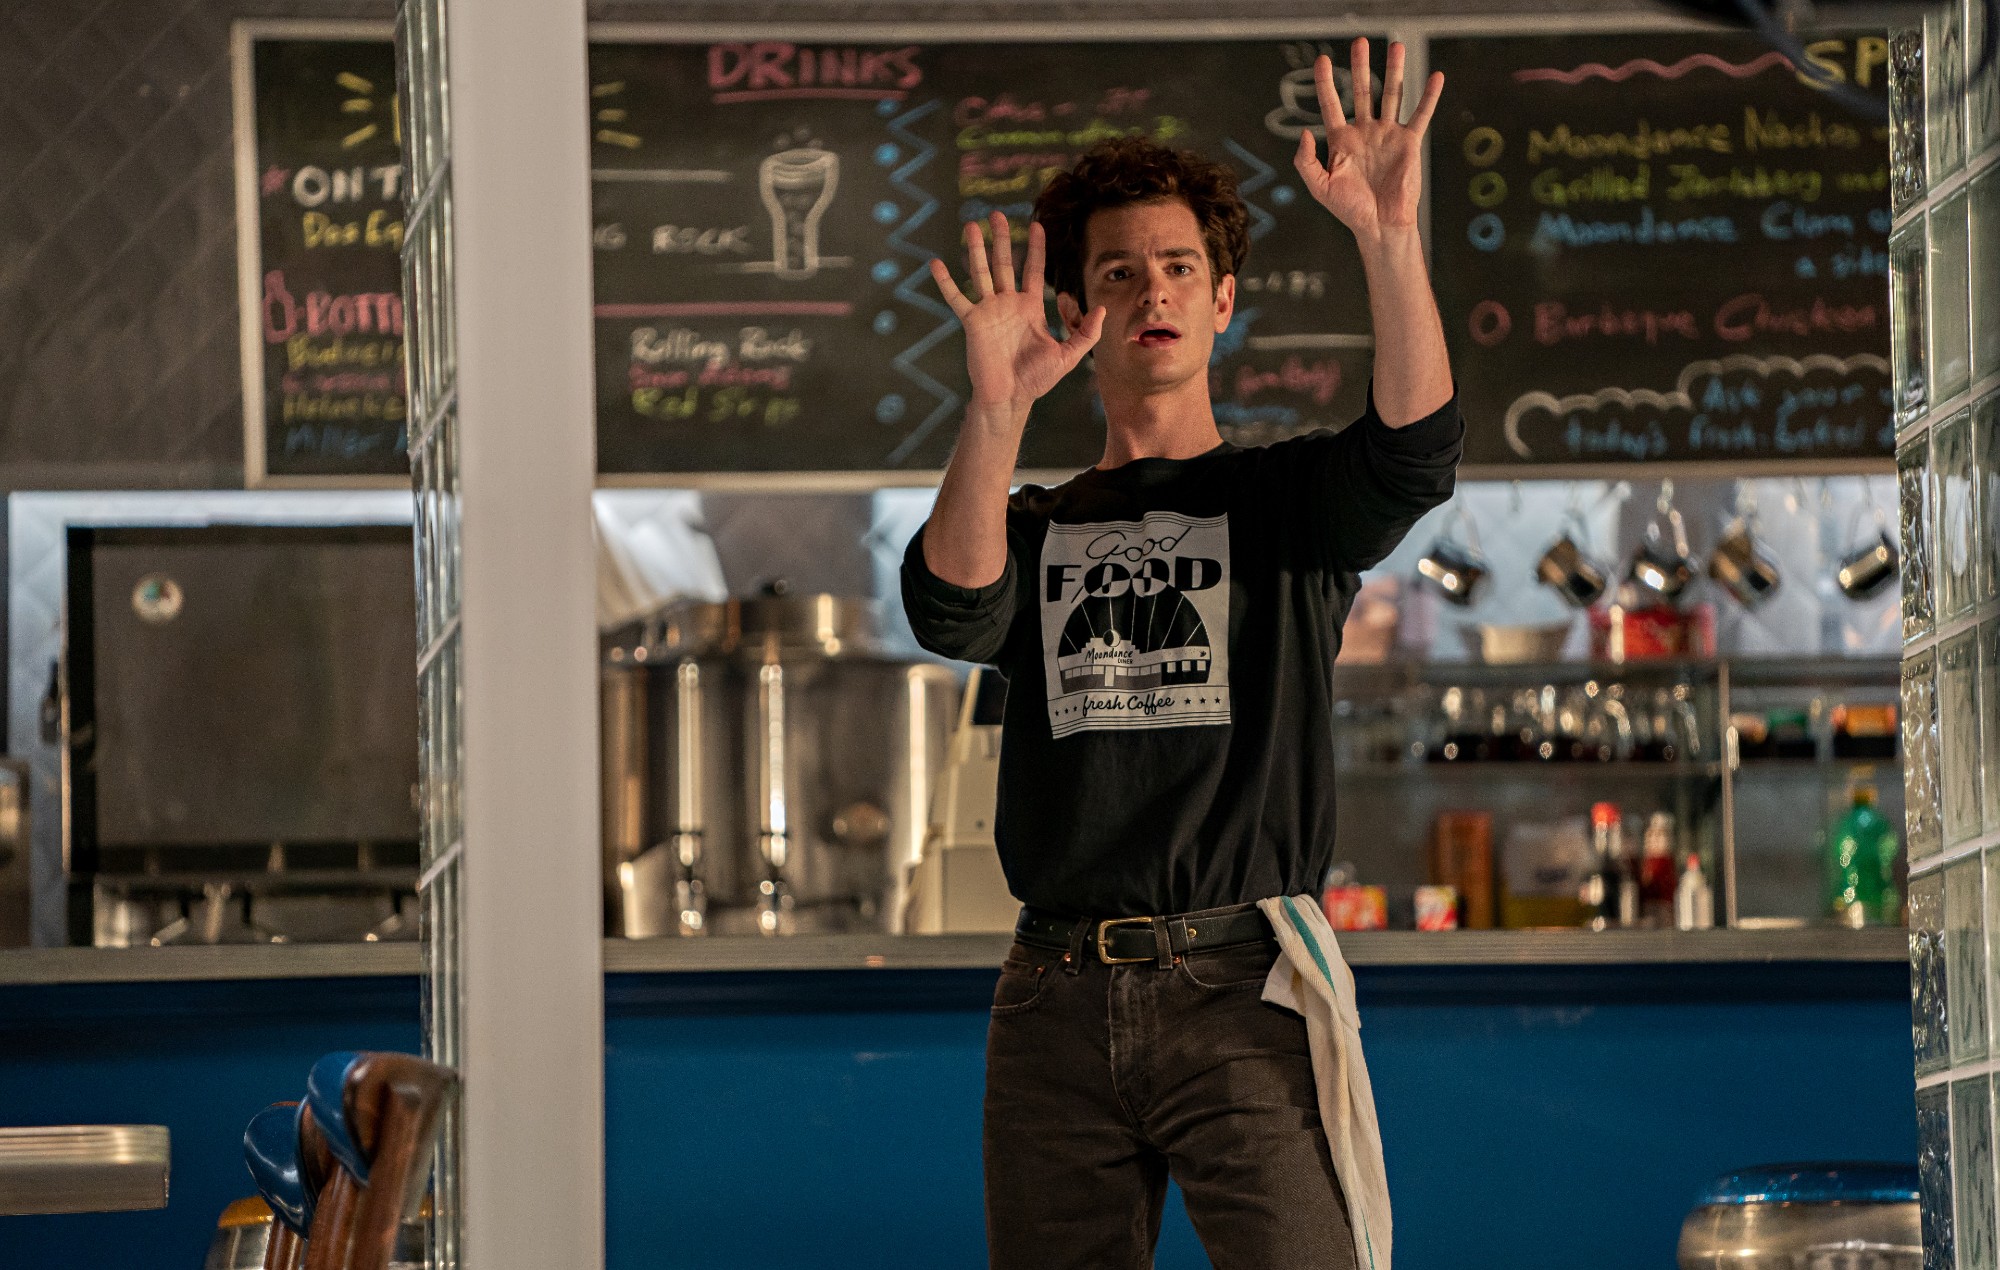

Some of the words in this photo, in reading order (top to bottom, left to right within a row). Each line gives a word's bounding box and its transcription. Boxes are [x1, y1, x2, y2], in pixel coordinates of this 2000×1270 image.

[707, 40, 923, 88] DRINKS
[292, 164, 364, 208] ON
[1085, 525, 1193, 565] Good
[1046, 555, 1223, 603] FOOD
[1085, 647, 1134, 664] Moondance
[1081, 694, 1126, 717] fresh
[1127, 692, 1176, 716] Coffee
